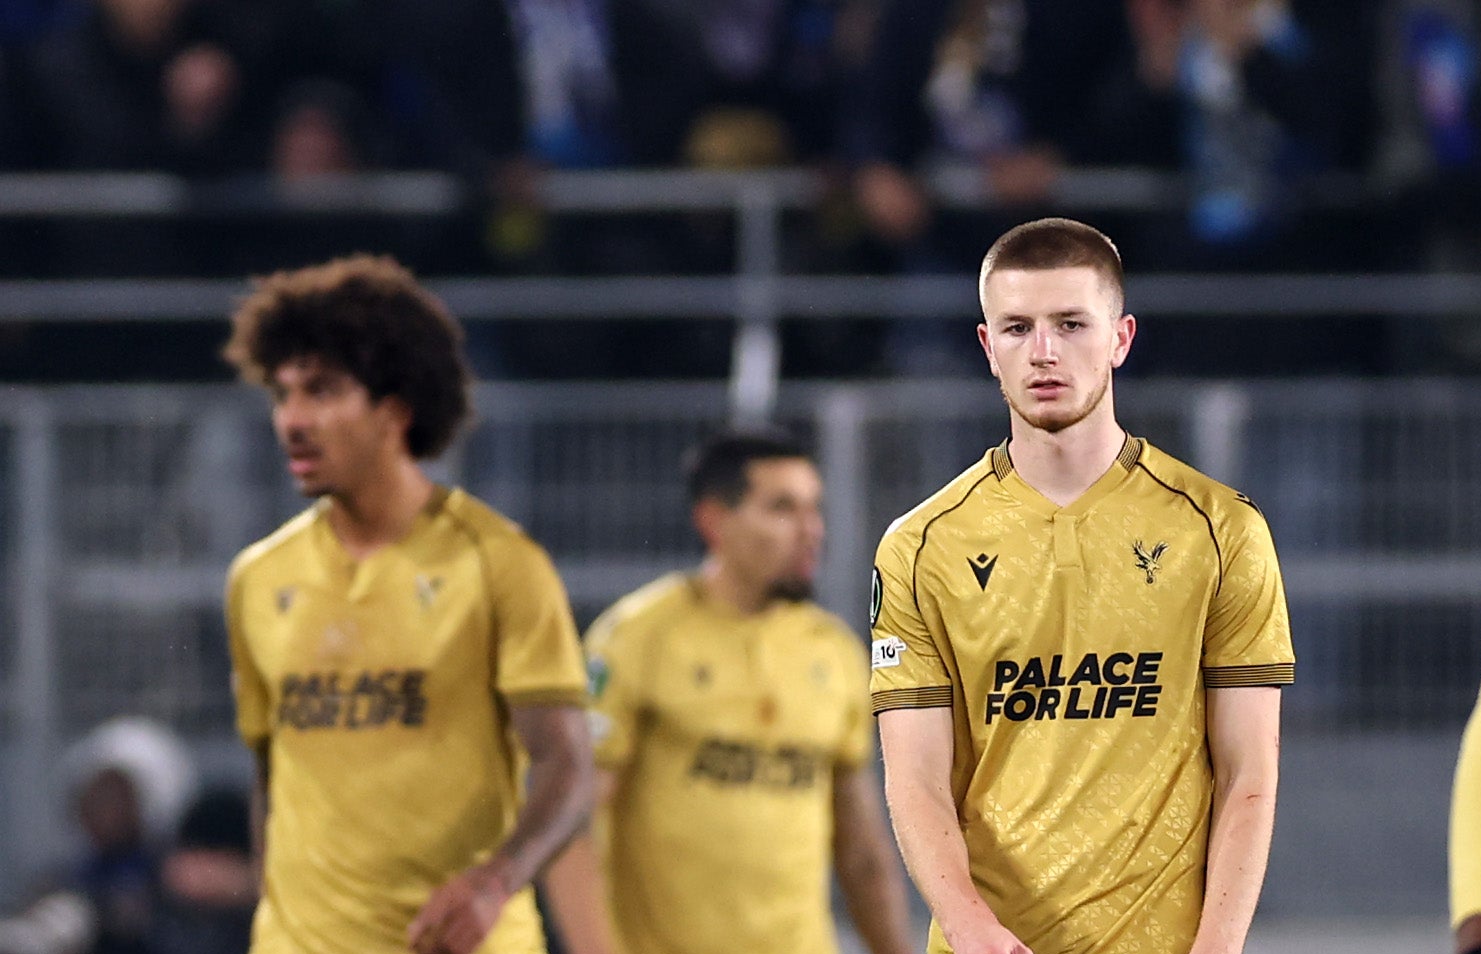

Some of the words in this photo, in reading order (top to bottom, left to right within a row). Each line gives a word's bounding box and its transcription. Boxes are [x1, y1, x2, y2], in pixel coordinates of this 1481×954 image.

[994, 652, 1163, 692] PALACE
[985, 689, 1061, 725] FOR
[1064, 685, 1163, 719] LIFE
